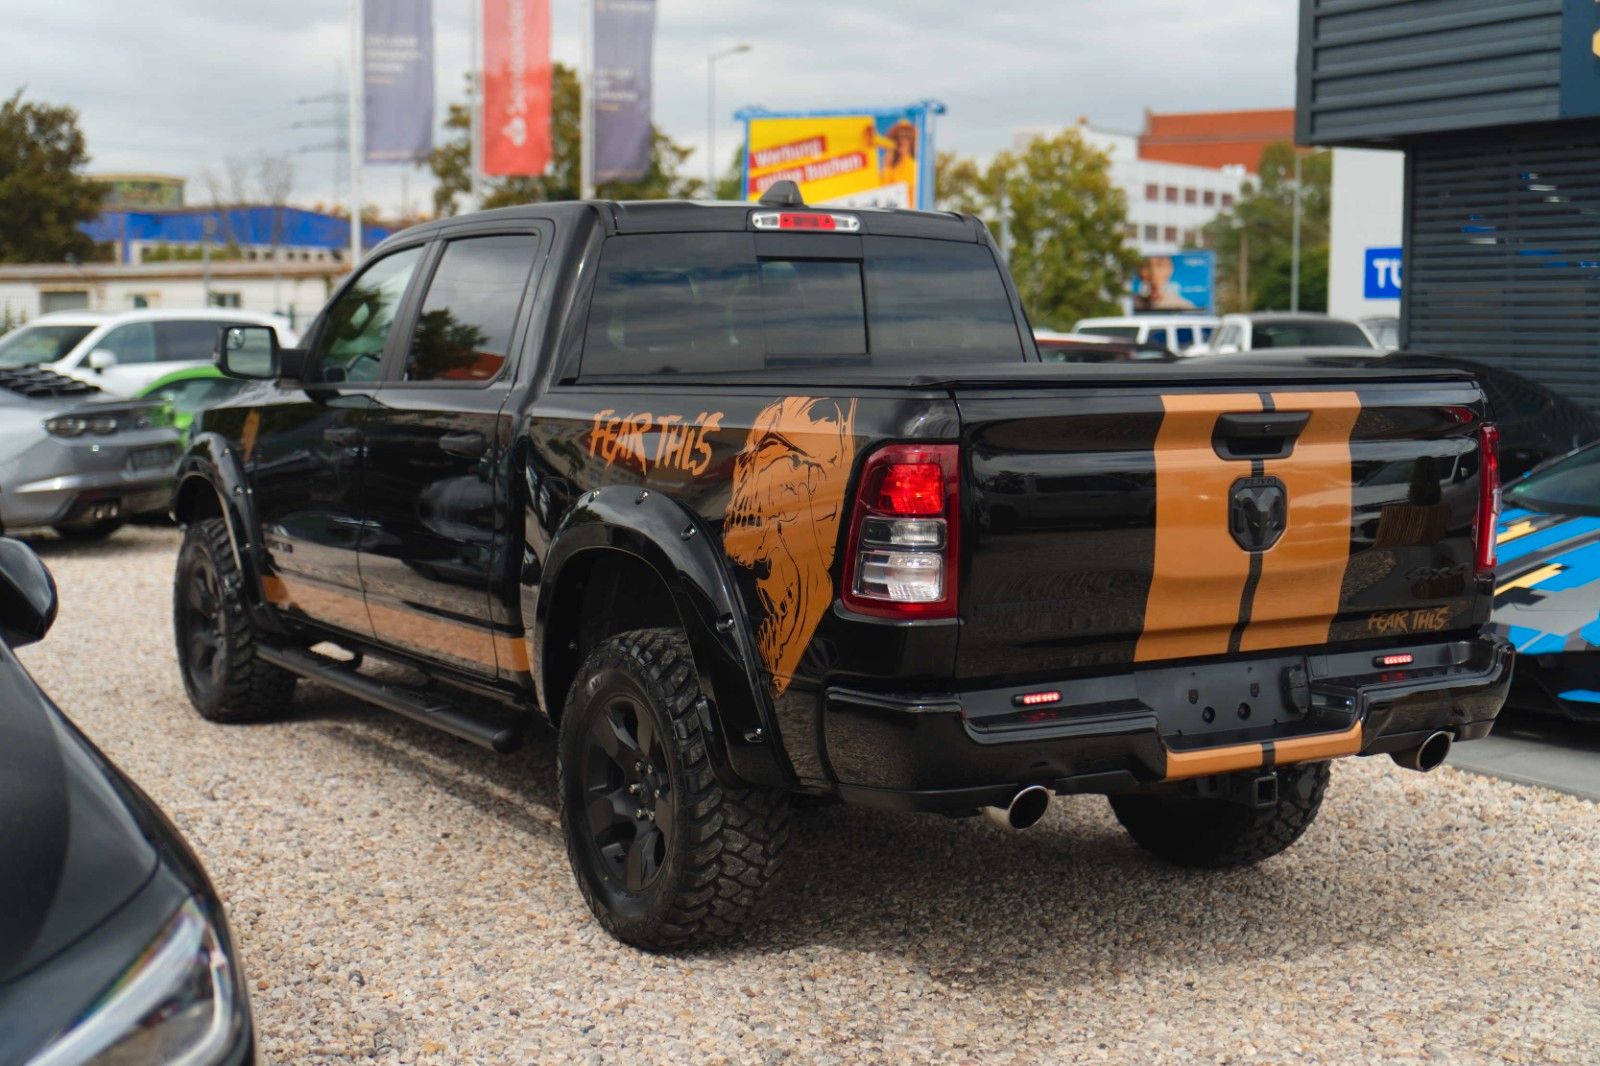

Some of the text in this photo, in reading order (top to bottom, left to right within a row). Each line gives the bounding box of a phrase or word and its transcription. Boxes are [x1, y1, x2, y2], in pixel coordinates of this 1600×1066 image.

[588, 409, 724, 476] FEAR THIS
[1367, 607, 1449, 633] FEAR THIS
